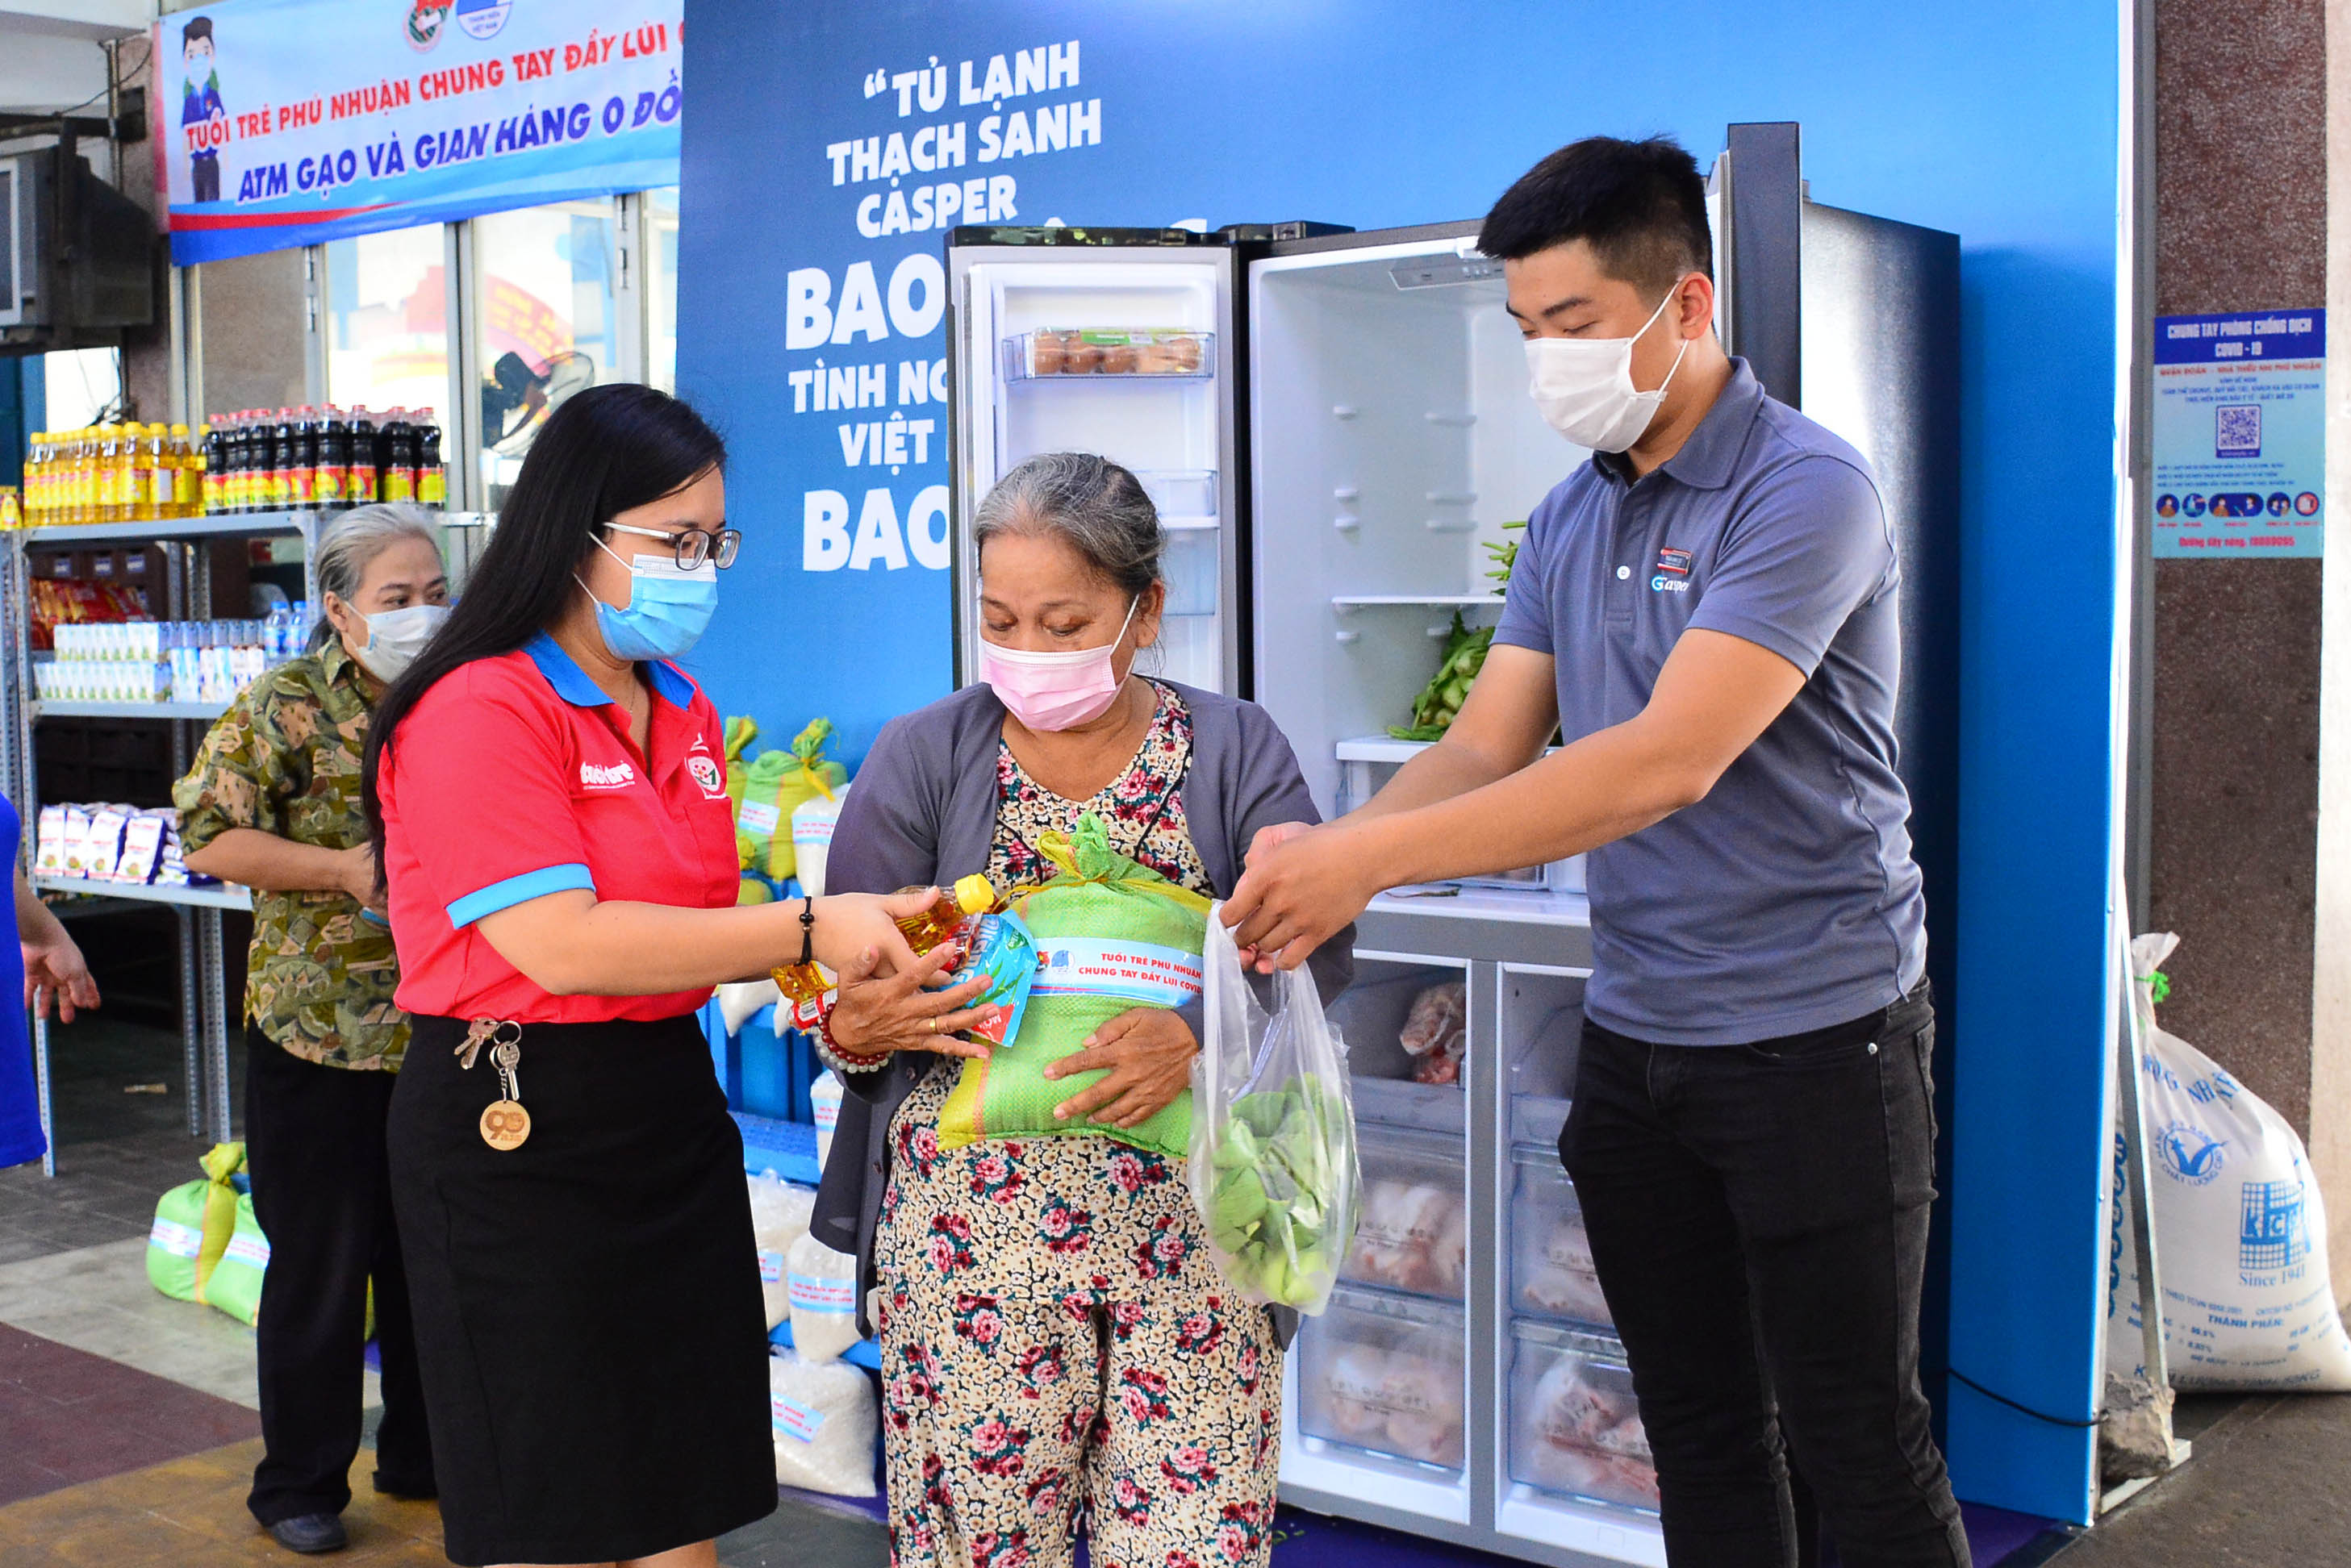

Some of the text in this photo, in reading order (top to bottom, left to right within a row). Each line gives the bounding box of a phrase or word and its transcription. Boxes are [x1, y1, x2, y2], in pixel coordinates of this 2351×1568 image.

[420, 60, 505, 101] CHUNG
[512, 48, 555, 81] TAY
[958, 40, 1080, 111] LẠNH
[238, 163, 287, 202] ATM
[296, 148, 357, 197] GẠO
[366, 131, 405, 177] VÀ
[415, 123, 491, 169] GIAN
[826, 98, 1101, 187] THẠCH SANH
[856, 174, 1018, 239] CASPER
[786, 252, 946, 350] BAO
[788, 358, 886, 414] TÌNH
[837, 411, 935, 475] VIỆT
[803, 484, 950, 572] BAO
[1079, 967, 1117, 976] CHUNG
[1121, 969, 1138, 978] TAY
[2240, 1271, 2276, 1287] Since
